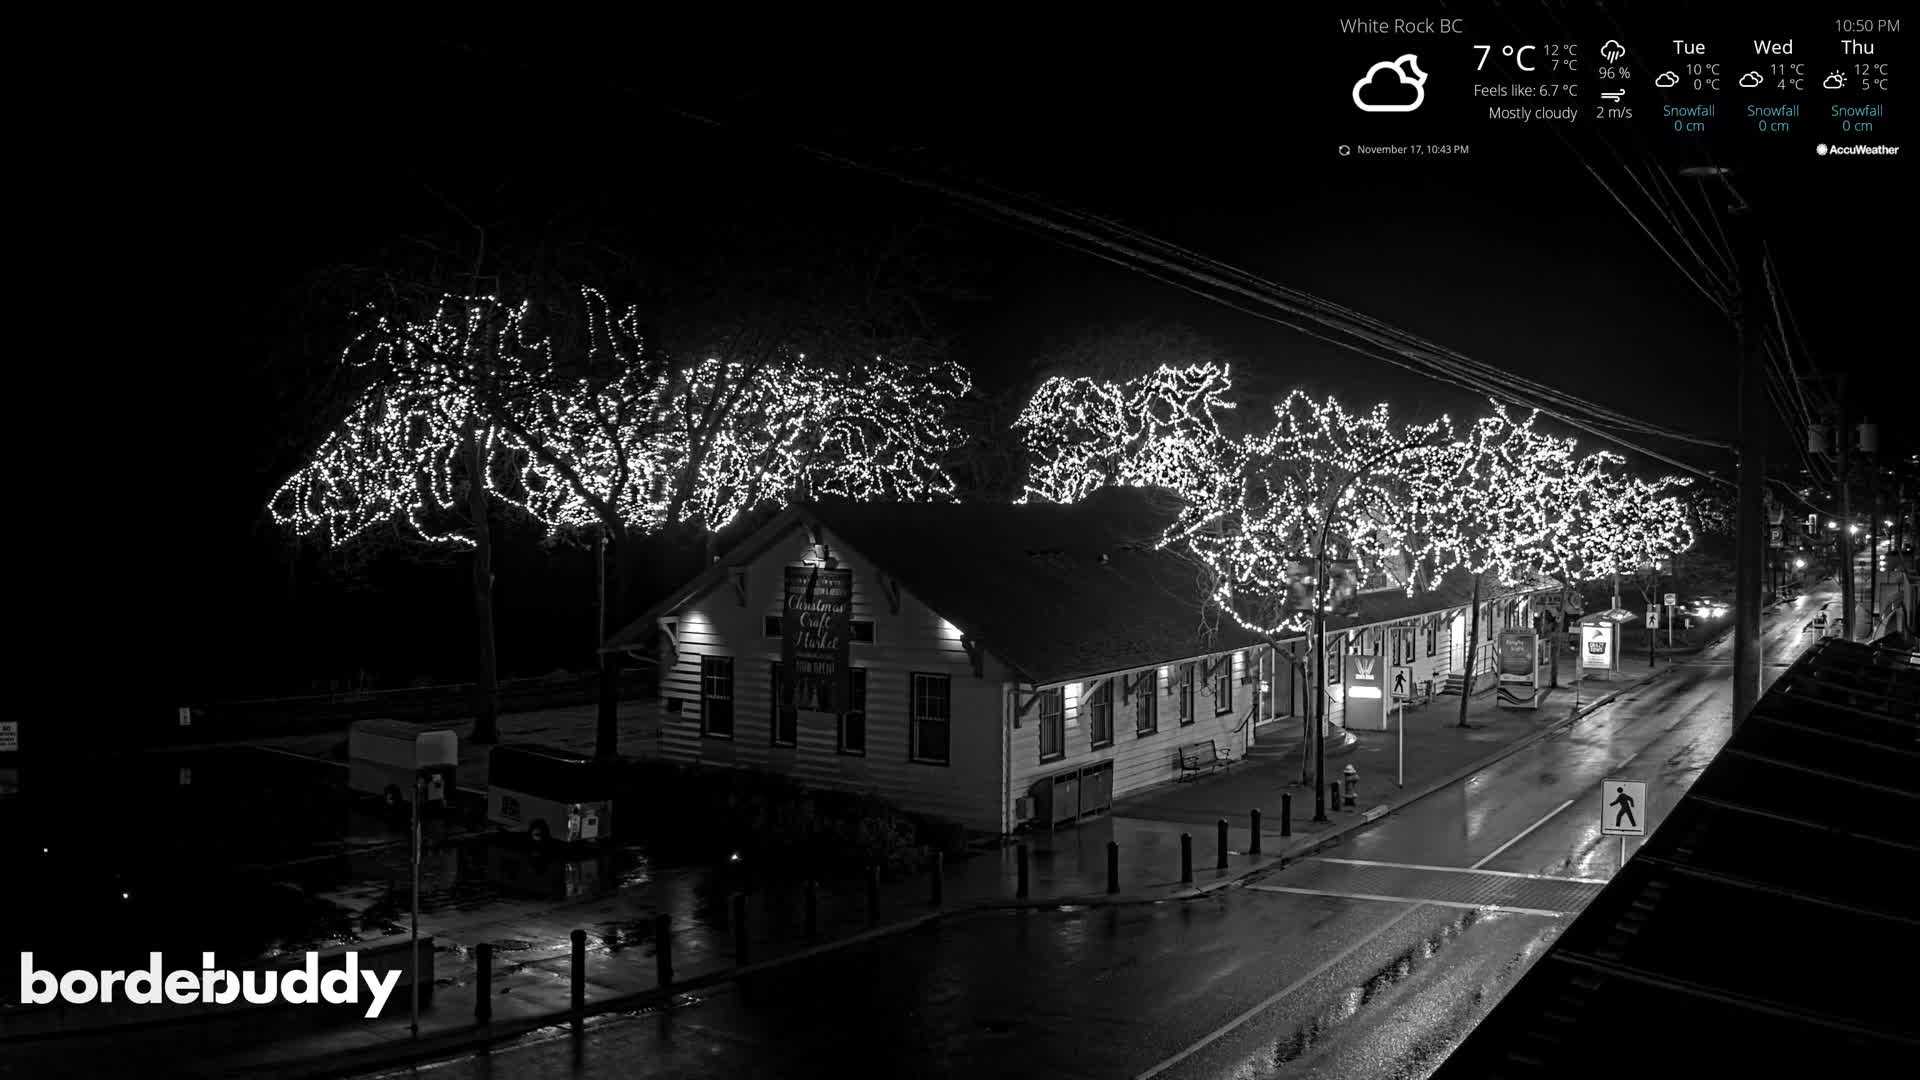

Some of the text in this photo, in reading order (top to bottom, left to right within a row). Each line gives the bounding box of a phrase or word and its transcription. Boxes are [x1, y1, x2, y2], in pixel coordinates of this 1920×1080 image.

[788, 596, 846, 613] Christmas
[800, 613, 831, 635] Craft
[796, 632, 838, 648] Market
